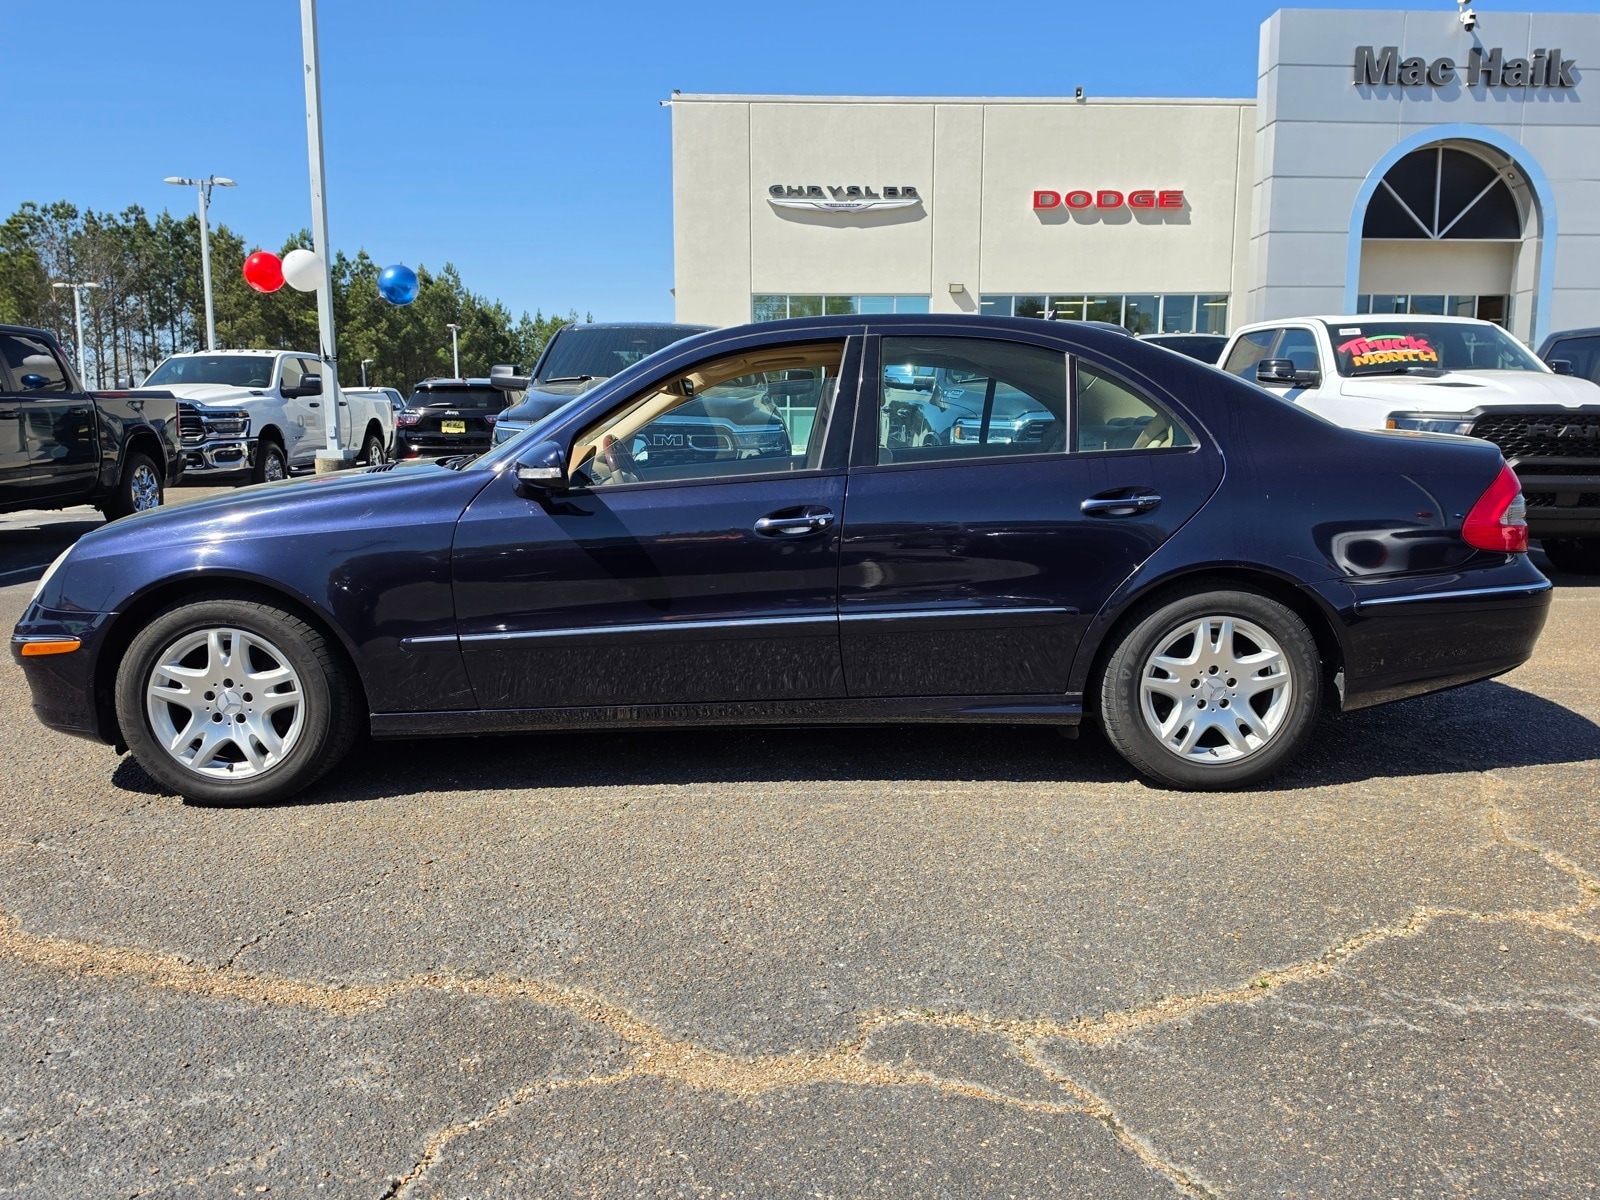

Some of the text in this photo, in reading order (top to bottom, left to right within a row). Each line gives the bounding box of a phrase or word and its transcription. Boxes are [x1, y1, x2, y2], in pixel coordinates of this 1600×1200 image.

[1353, 46, 1576, 87] Mac Haik
[769, 185, 918, 199] CHRYSLER
[1033, 190, 1184, 209] DODGE
[1338, 335, 1434, 356] Truck
[1352, 350, 1438, 367] MONTH
